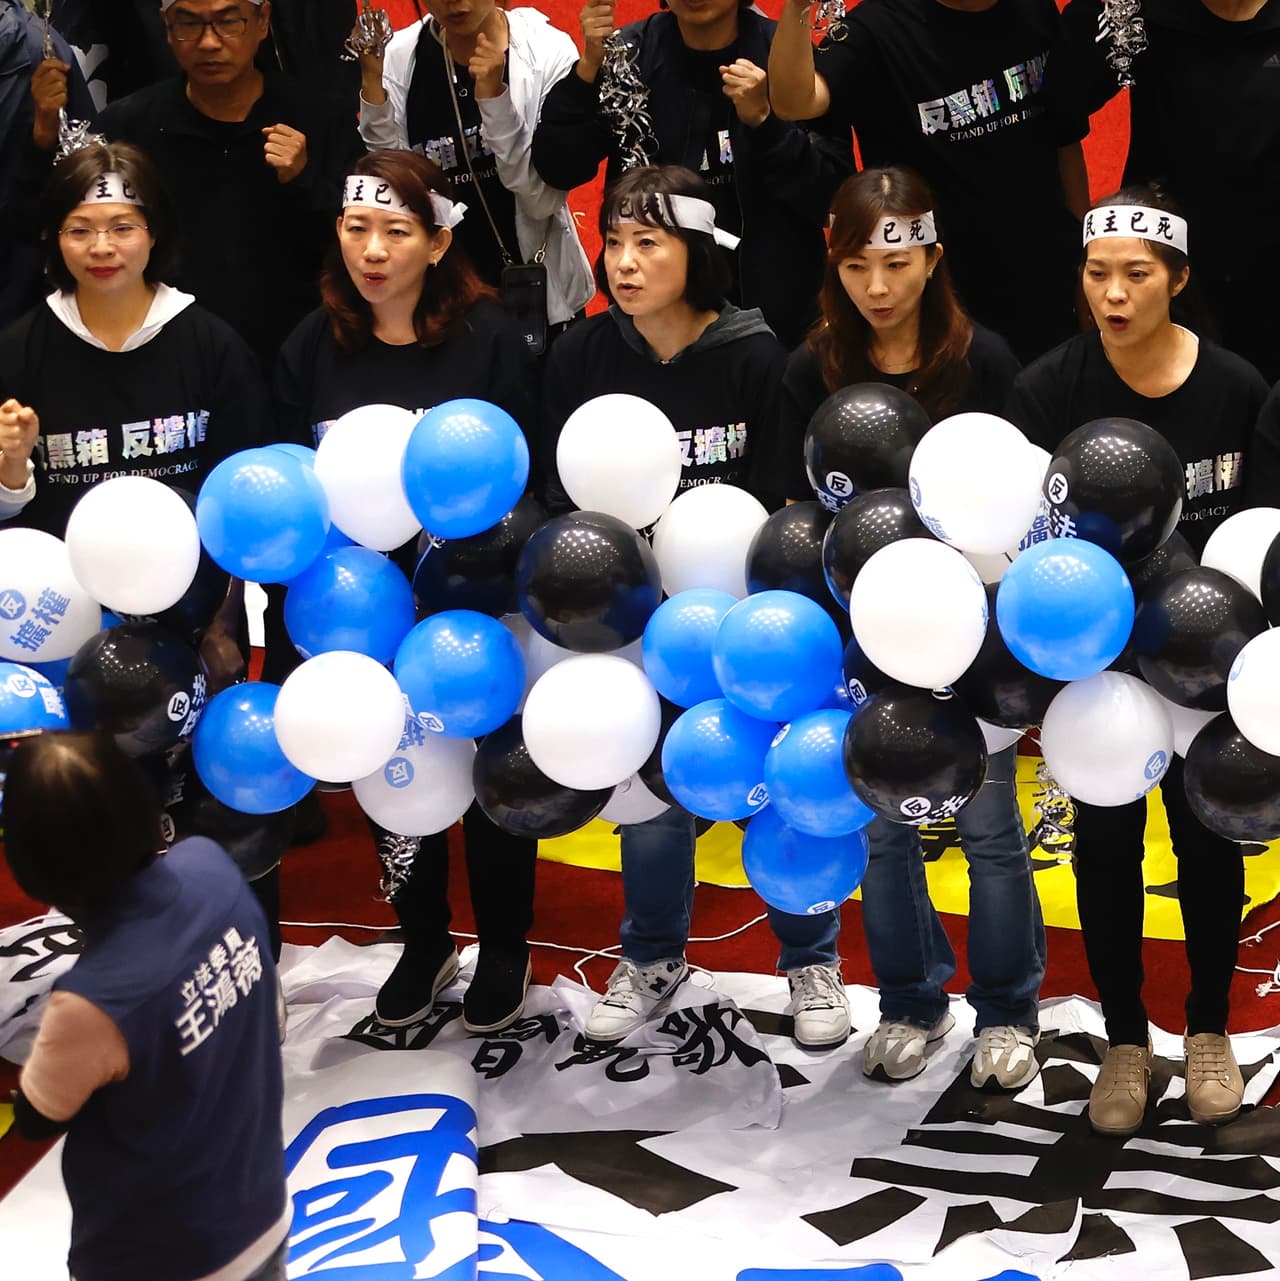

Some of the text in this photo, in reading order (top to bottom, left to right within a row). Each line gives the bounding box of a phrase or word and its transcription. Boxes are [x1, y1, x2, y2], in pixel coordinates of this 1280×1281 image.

[917, 78, 1002, 137] 反黑箱
[949, 125, 984, 142] STAND
[868, 219, 925, 244] 已死
[1085, 209, 1174, 241] 民主已死
[82, 472, 99, 484] UP
[173, 936, 265, 1057] 王鴻薇
